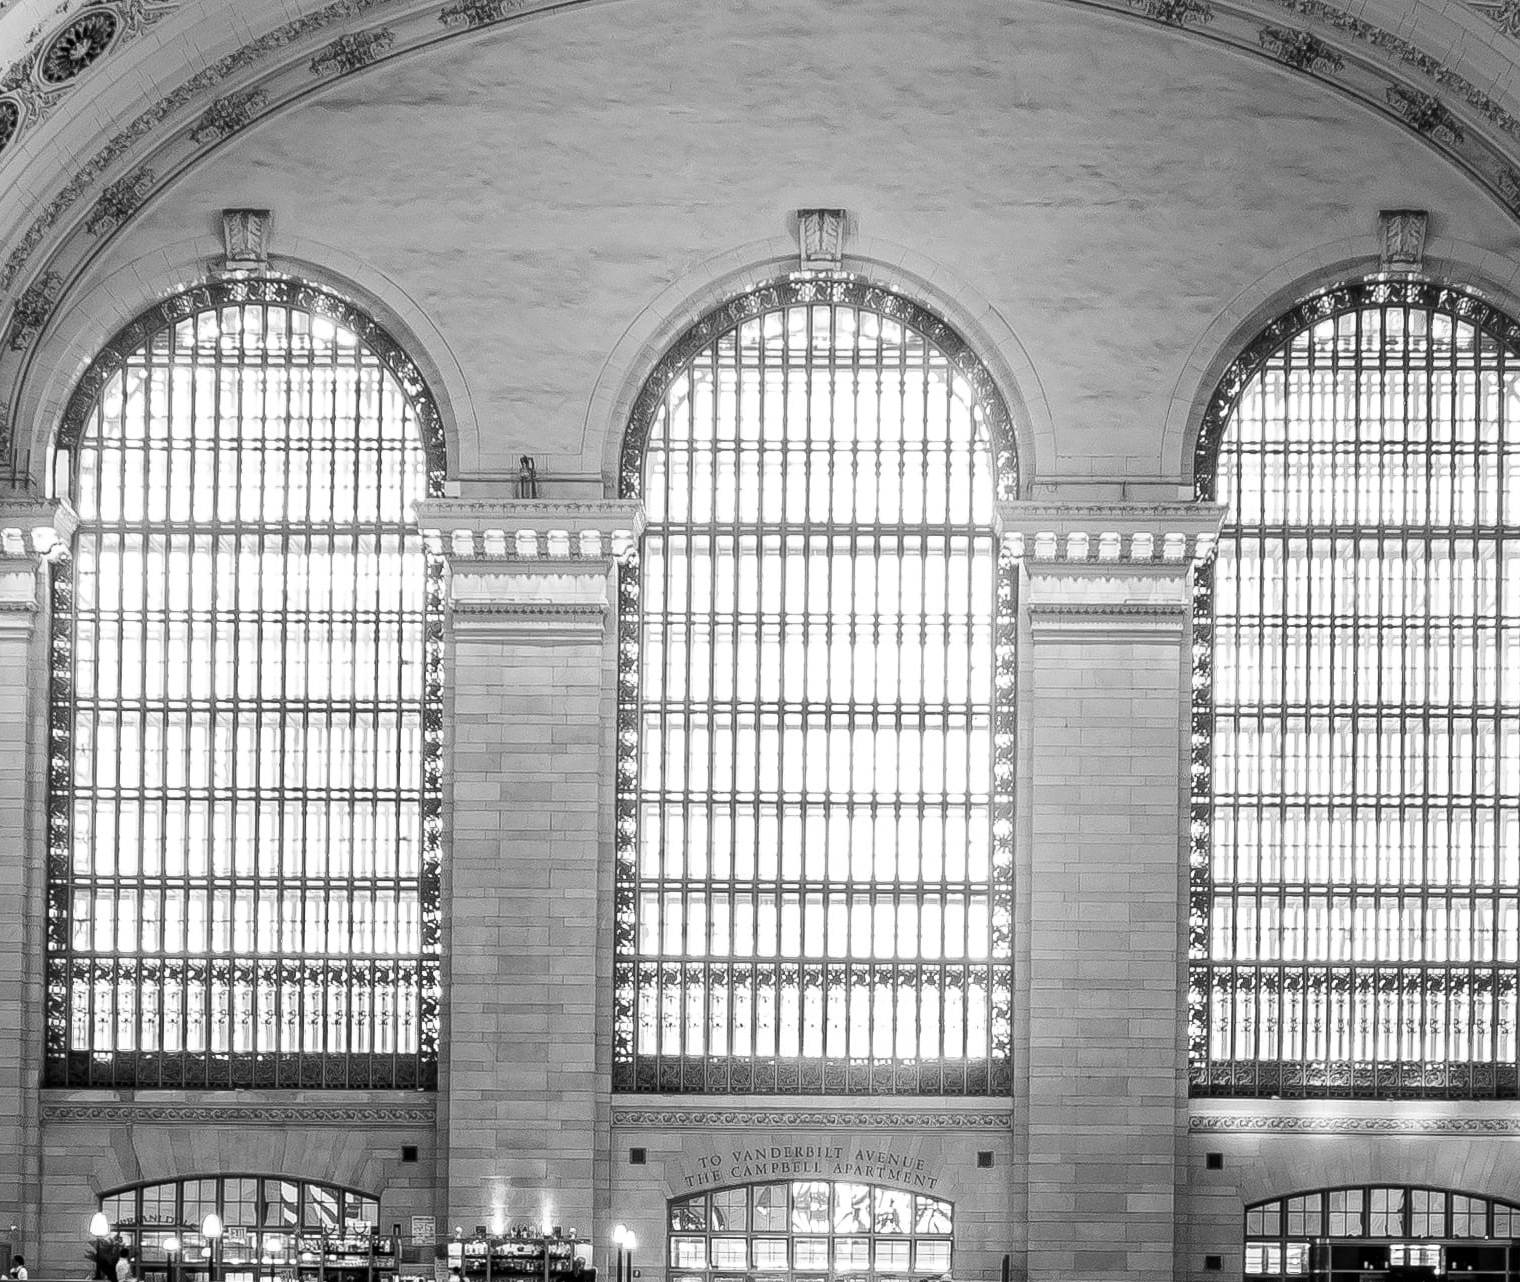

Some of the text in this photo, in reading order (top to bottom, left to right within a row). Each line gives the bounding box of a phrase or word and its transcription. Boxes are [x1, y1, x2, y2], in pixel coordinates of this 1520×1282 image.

[698, 1147, 926, 1171] TO VANDERBILT AVENUE
[684, 1161, 938, 1189] THE CAMPBELL APARTMENT
